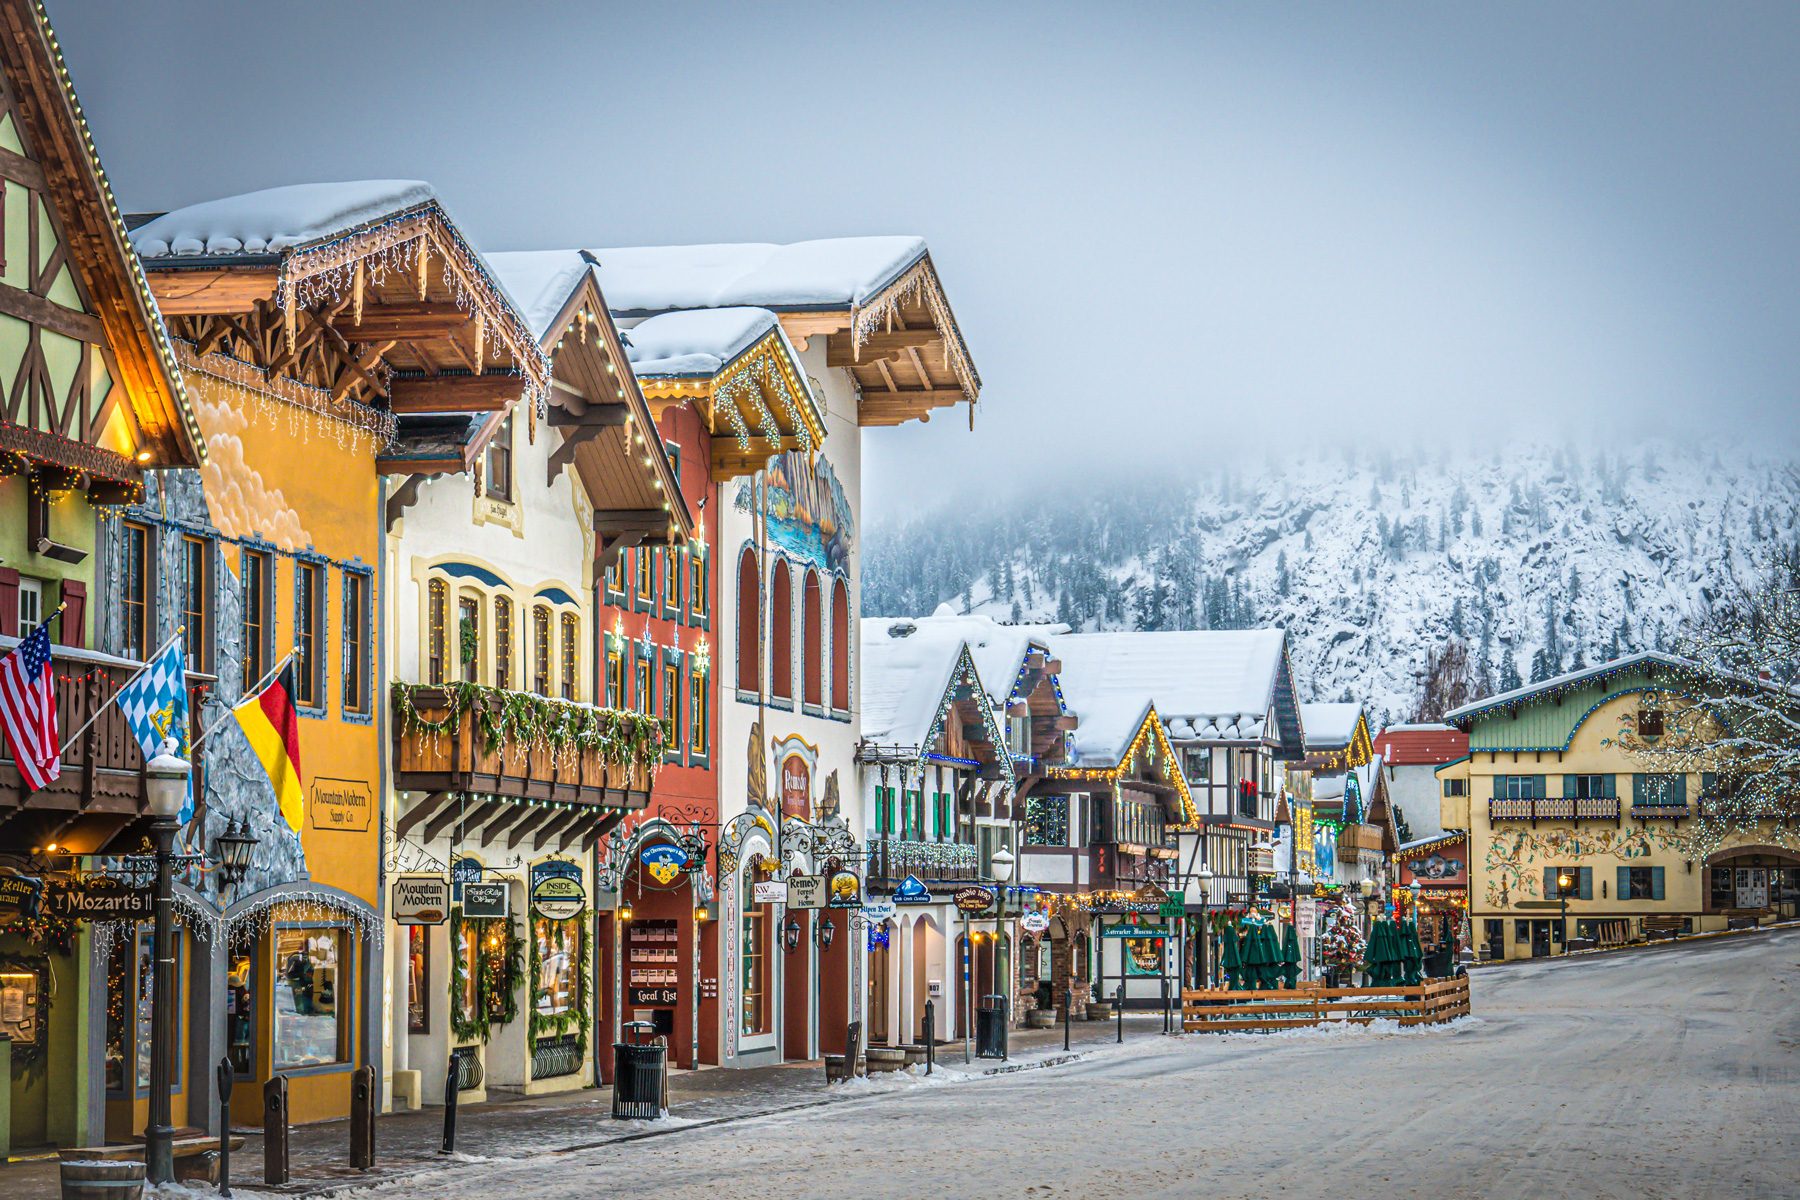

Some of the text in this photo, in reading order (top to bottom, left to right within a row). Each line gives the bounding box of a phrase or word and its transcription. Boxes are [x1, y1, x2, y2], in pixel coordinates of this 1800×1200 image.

[314, 787, 366, 807] Mountain Modern
[2, 878, 33, 895] Keller
[398, 883, 442, 895] Mountain
[546, 882, 572, 890] INSIDE
[790, 876, 821, 890] Remedy
[755, 885, 770, 894] KW
[797, 888, 815, 896] Forest
[955, 888, 976, 901] Studio
[66, 891, 142, 914] Mozart's
[403, 894, 442, 906] Modern
[798, 899, 815, 907] Home
[1161, 907, 1183, 915] STEIN
[637, 990, 658, 1003] Local
